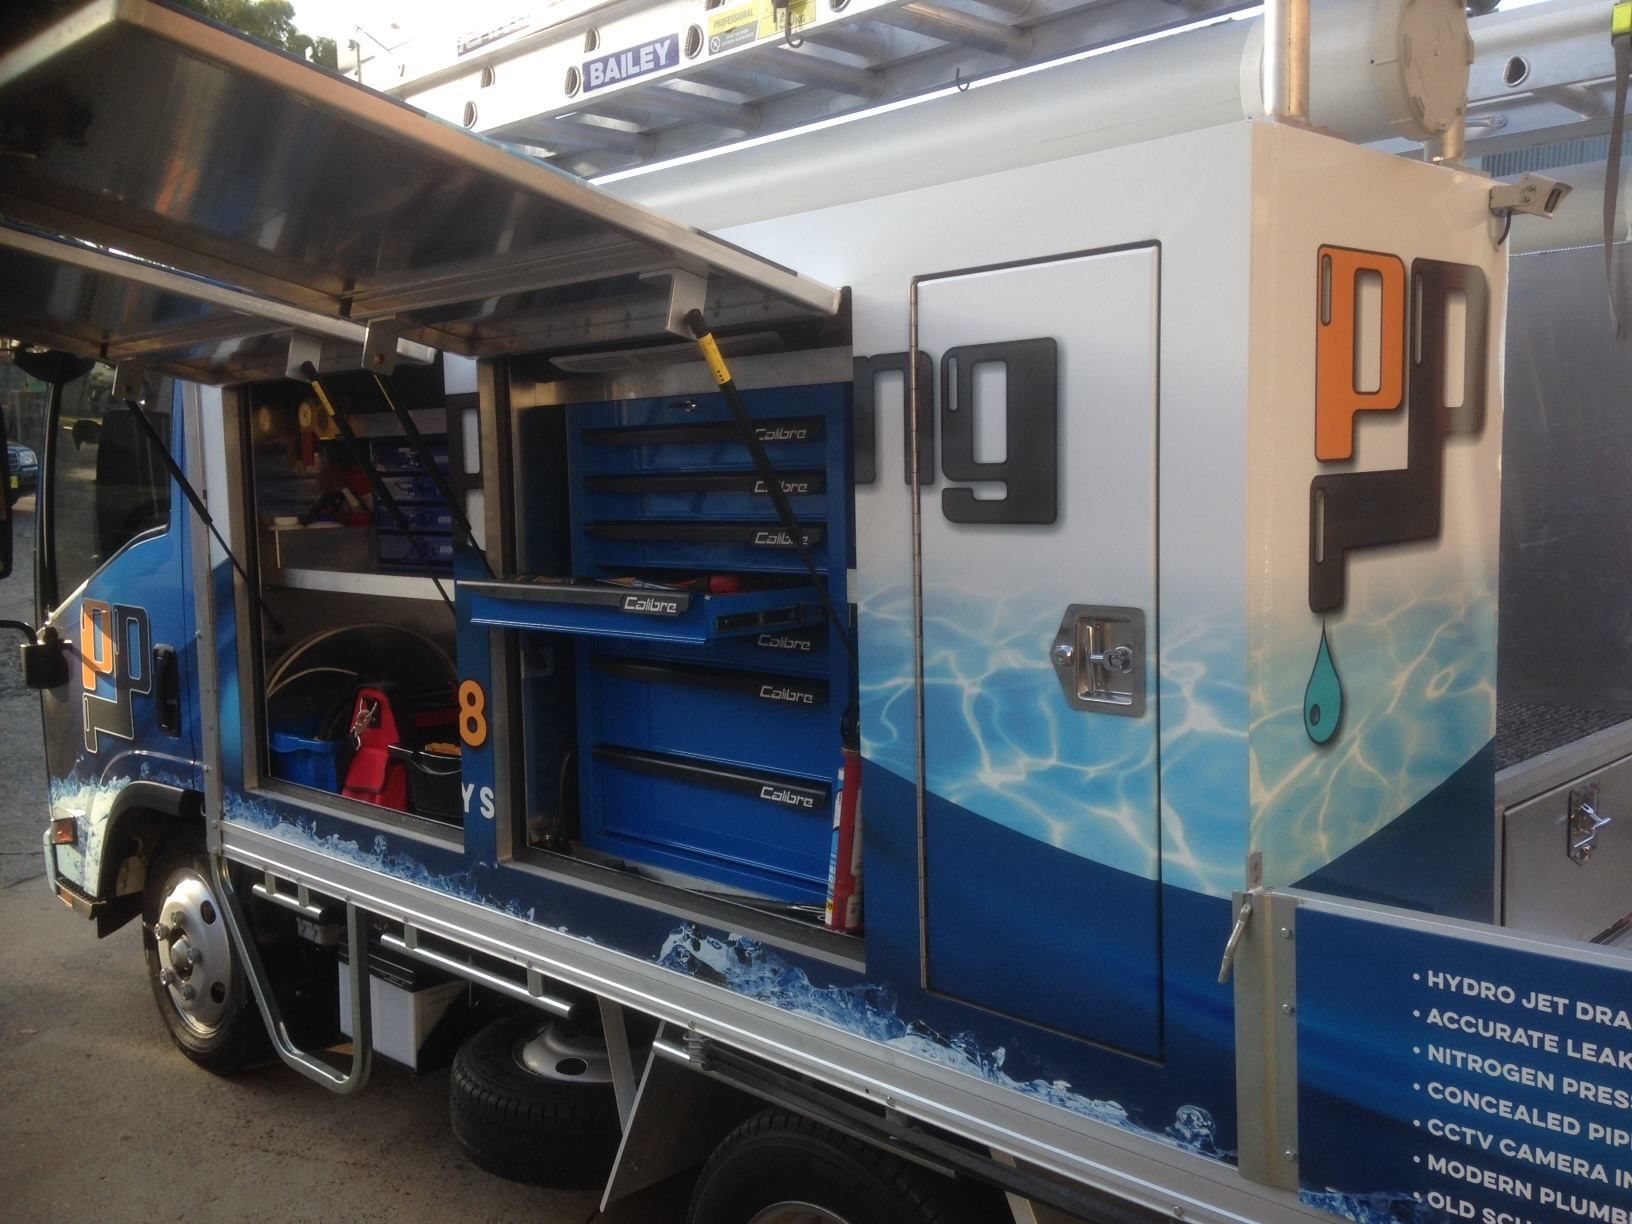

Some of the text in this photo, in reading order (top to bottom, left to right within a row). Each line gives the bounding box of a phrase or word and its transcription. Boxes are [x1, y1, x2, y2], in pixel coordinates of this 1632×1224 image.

[713, 8, 753, 29] PROFESSIONAL
[589, 40, 671, 87] BAILEY
[754, 481, 808, 493] Cbre
[754, 532, 809, 545] Calibe
[624, 596, 678, 614] Calibre
[757, 634, 812, 651] Calibre
[458, 679, 487, 747] 8
[759, 685, 813, 704] Calibre
[760, 786, 813, 808] Calibre
[1427, 970, 1632, 1031] HYDRO JET DRA
[1426, 1008, 1632, 1071] ACCURATE LEAK
[1428, 1044, 1632, 1109] NITROGEN PRES
[1427, 1082, 1632, 1150] CONCEALED PIP
[1427, 1118, 1494, 1150] CCTV
[1499, 1138, 1609, 1184] CAMERA
[1428, 1154, 1532, 1200] MODERN
[1427, 1191, 1475, 1219] OLD
